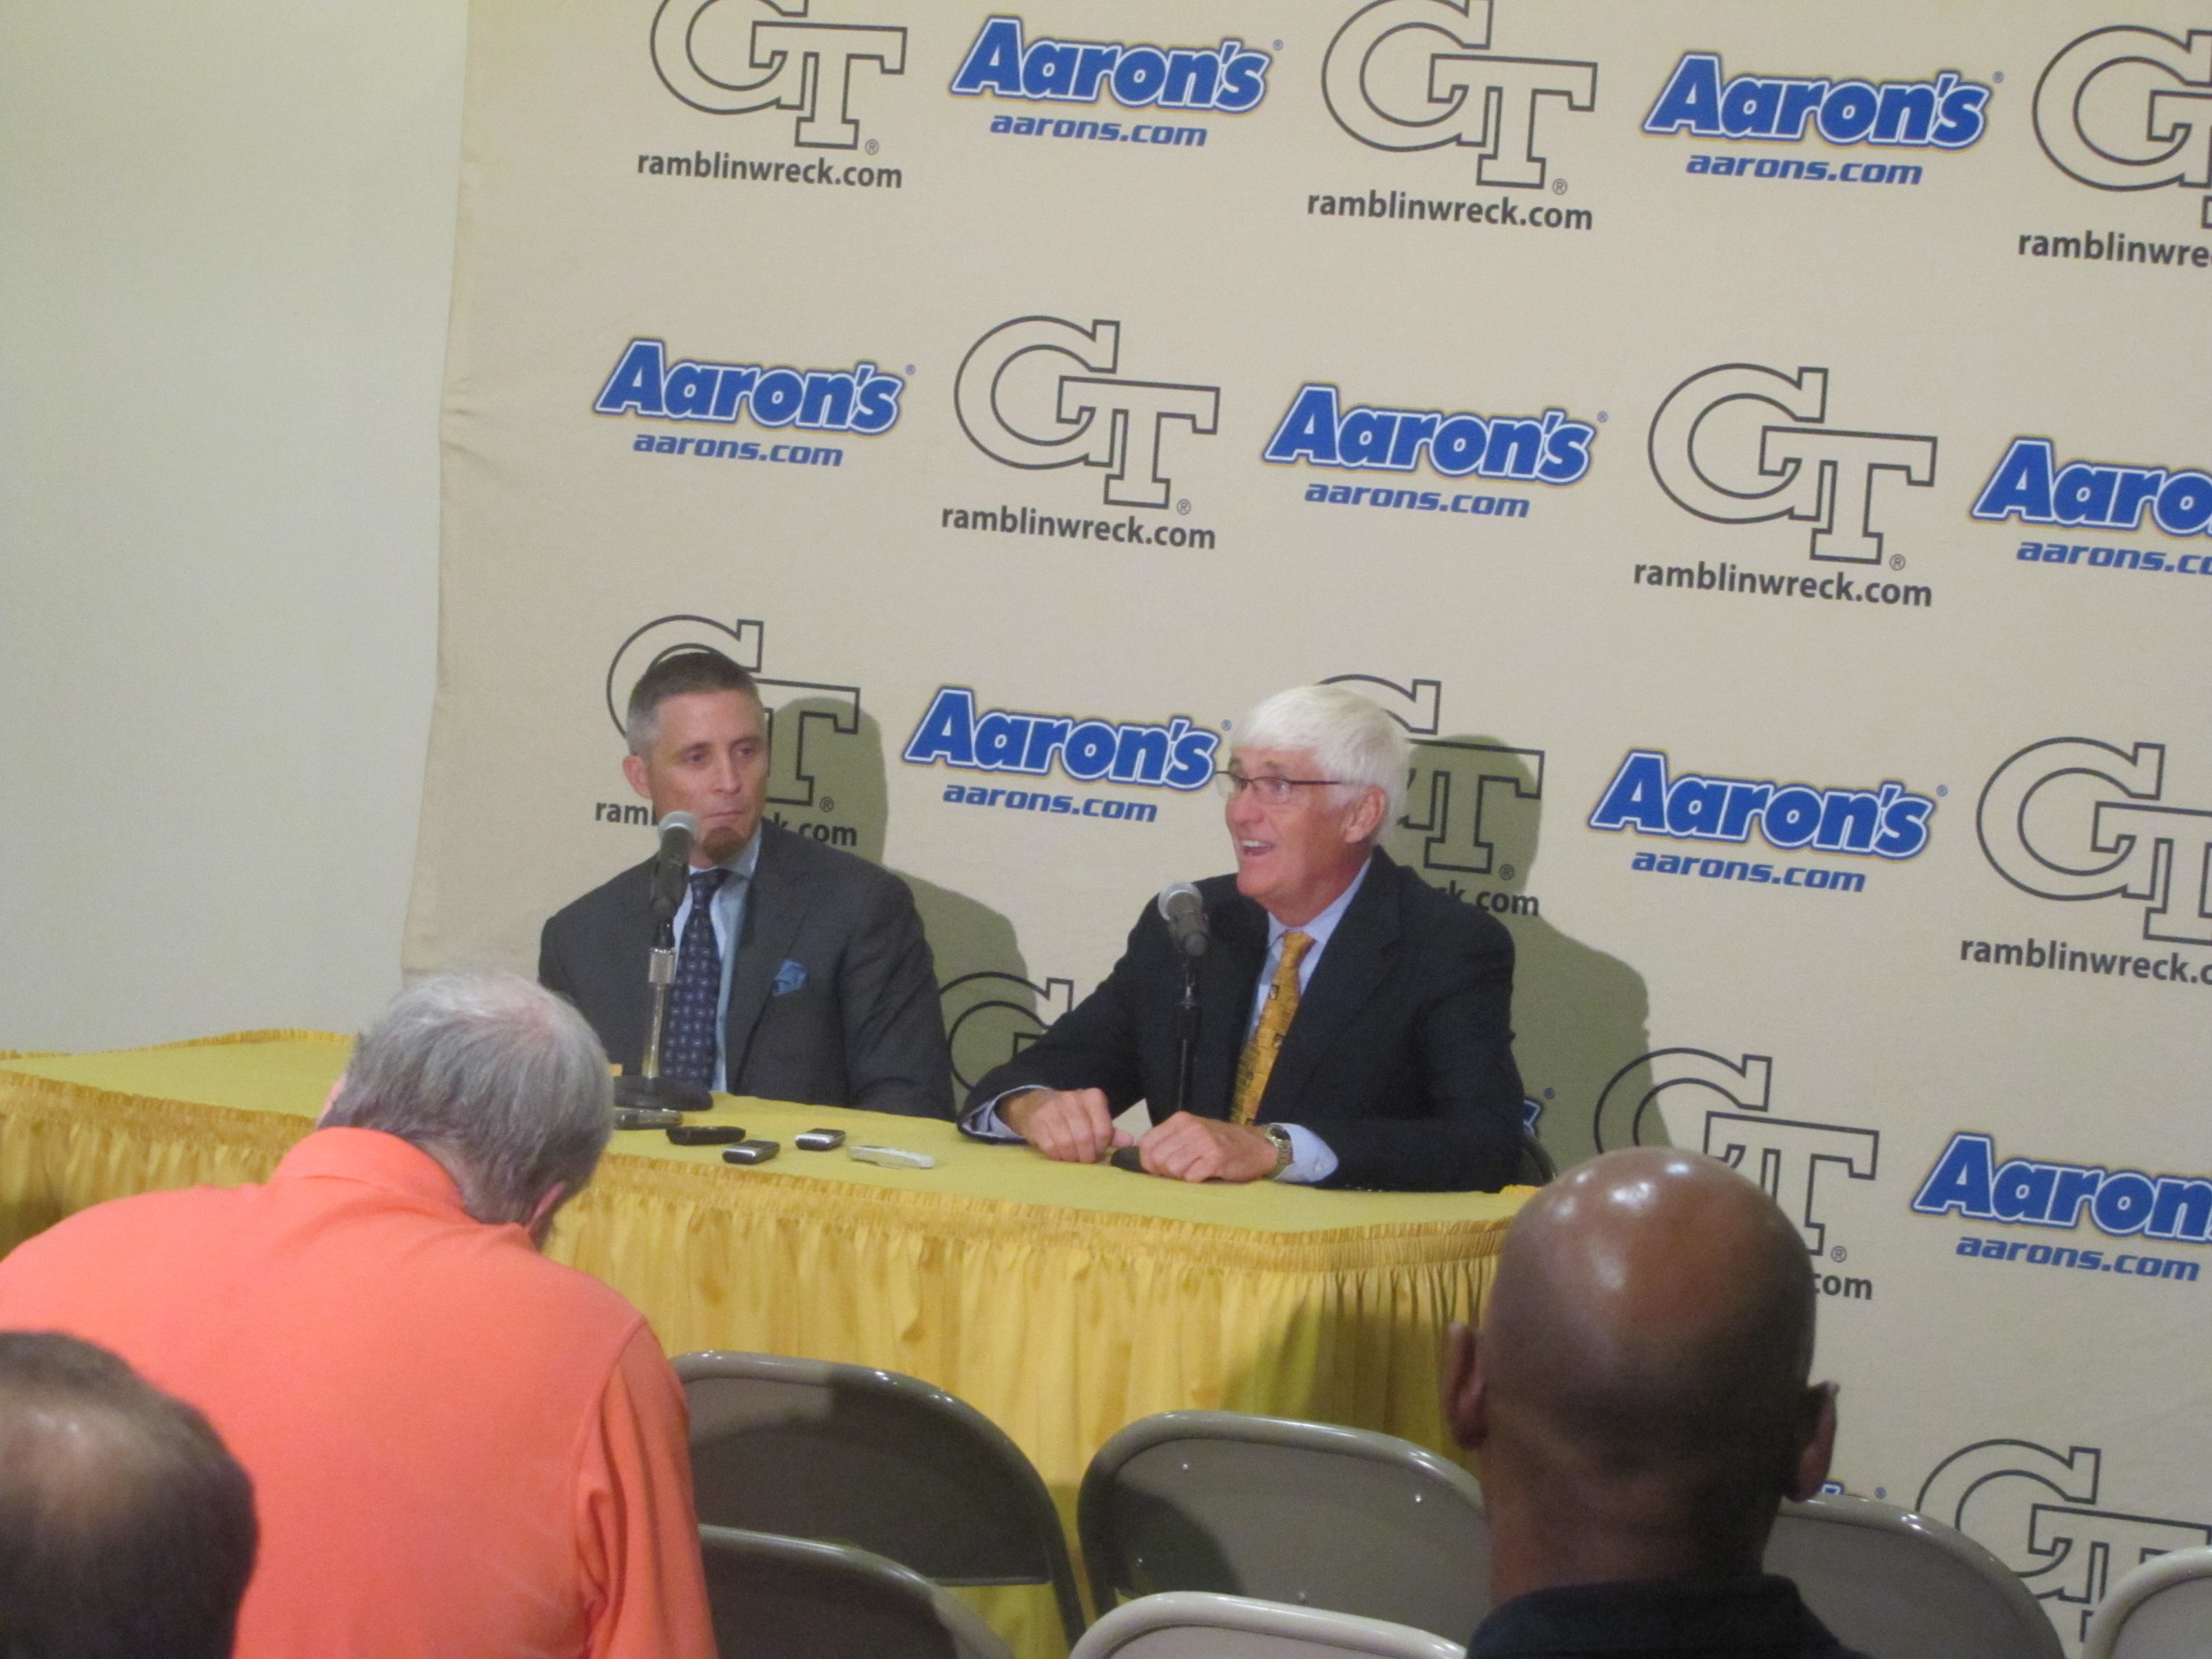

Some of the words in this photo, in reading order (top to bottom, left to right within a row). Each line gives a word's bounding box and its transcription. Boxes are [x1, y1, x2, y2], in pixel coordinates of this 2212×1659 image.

[650, 0, 908, 150] GT
[951, 16, 1271, 113] Aaron's
[1322, 0, 1598, 189] GT
[989, 114, 1208, 147] aarons.com
[1642, 51, 1991, 150] Aaron's
[637, 150, 902, 188] ramblinwreck.com
[1686, 154, 1923, 185] aarons.com
[1307, 190, 1593, 230] ramblinwreck.com
[2018, 229, 2212, 268] ramblinwre
[595, 338, 902, 435] Aaron's
[955, 315, 1220, 509] GT
[633, 434, 843, 466] aarons.com
[1263, 383, 1597, 486] Aaron's
[1648, 363, 1938, 565] GT
[1304, 482, 1530, 518] aarons.com
[1971, 437, 2212, 538] Aaro
[941, 504, 1216, 549] ramblinwreck.com
[1633, 561, 1932, 606] ramblinwreck.com
[902, 685, 1220, 792] Aaron's
[943, 785, 1157, 822] aarons.com
[1588, 749, 1935, 860] Aaron's
[1631, 851, 1865, 893] aarons.com
[1911, 1131, 2212, 1243] Aaron
[1955, 1237, 2200, 1282] aarons.com
